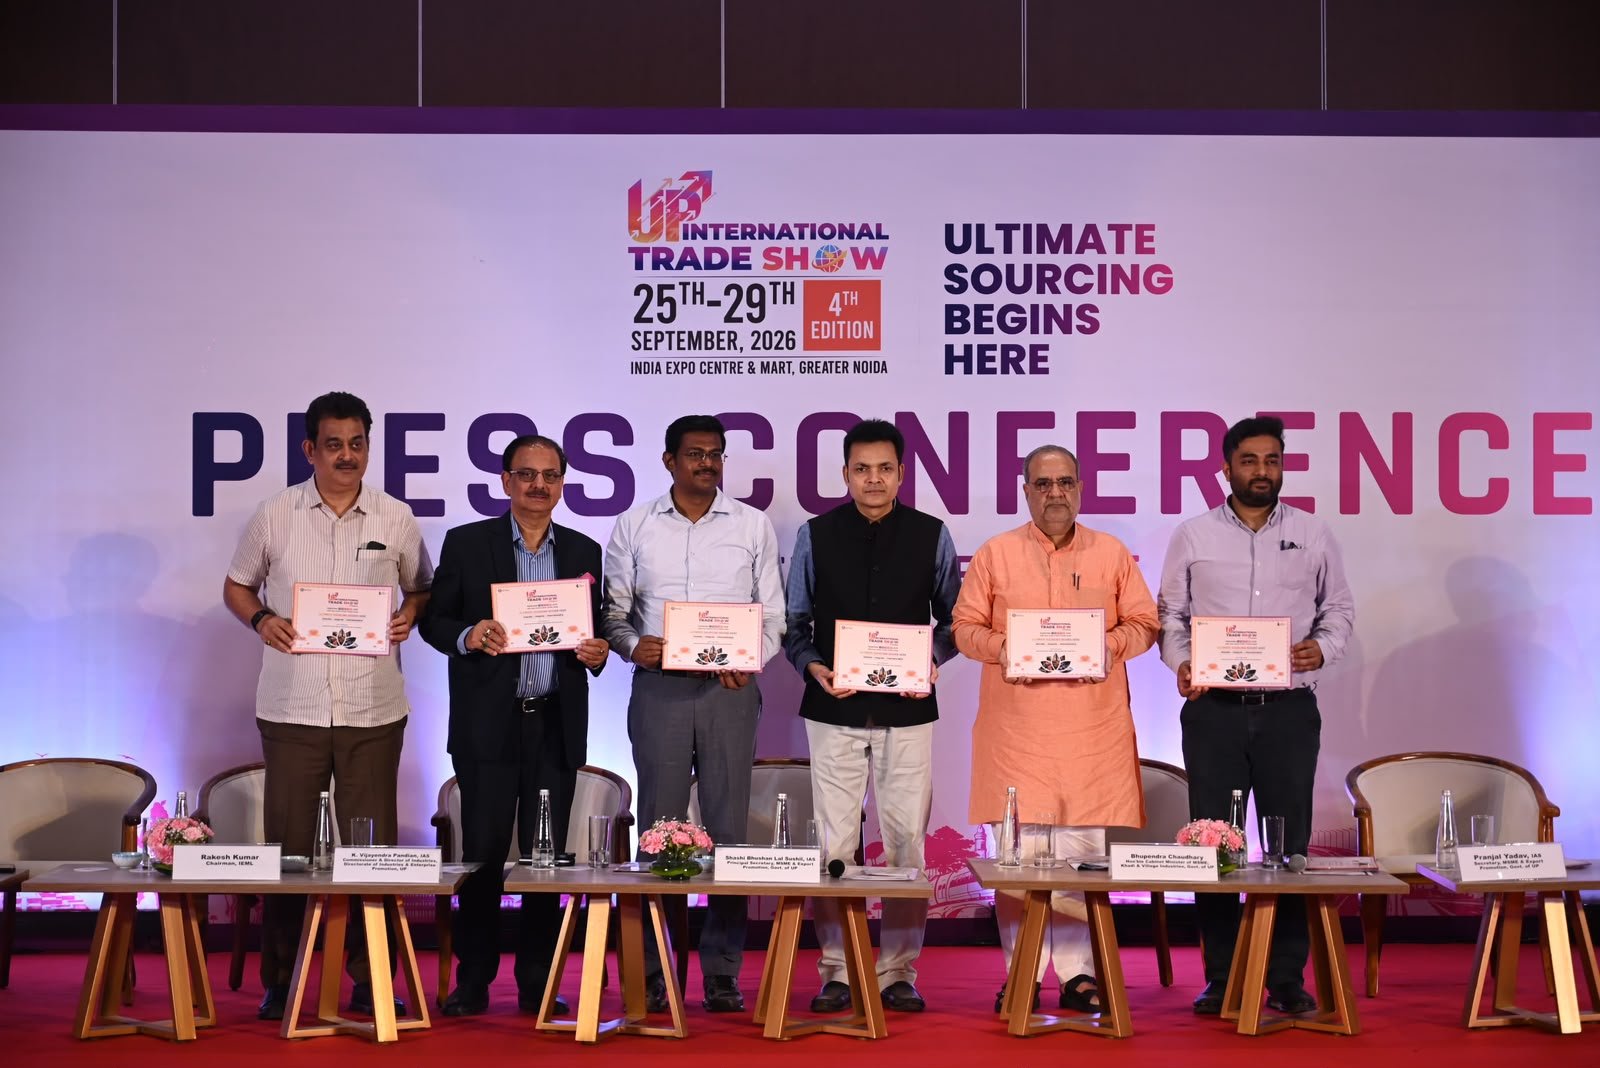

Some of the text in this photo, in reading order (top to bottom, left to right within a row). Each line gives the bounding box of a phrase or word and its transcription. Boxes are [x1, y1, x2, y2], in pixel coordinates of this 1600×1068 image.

[628, 170, 713, 243] UP
[683, 223, 889, 240] INTERNATIONAL
[945, 223, 1156, 254] ULTIMATE
[628, 247, 752, 270] TRADE
[944, 263, 1173, 294] SOURCING
[633, 281, 795, 324] 25TH-29TH
[828, 291, 858, 316] 4TH
[811, 321, 874, 339] EDITION
[945, 303, 1100, 335] BEGINS
[631, 330, 796, 352] SEPTEMBER, 2026
[631, 361, 888, 376] INDIA EXPO CENTRE & MART, GREATER NOIDA
[945, 344, 1049, 375] HERE
[192, 412, 636, 517] PESS
